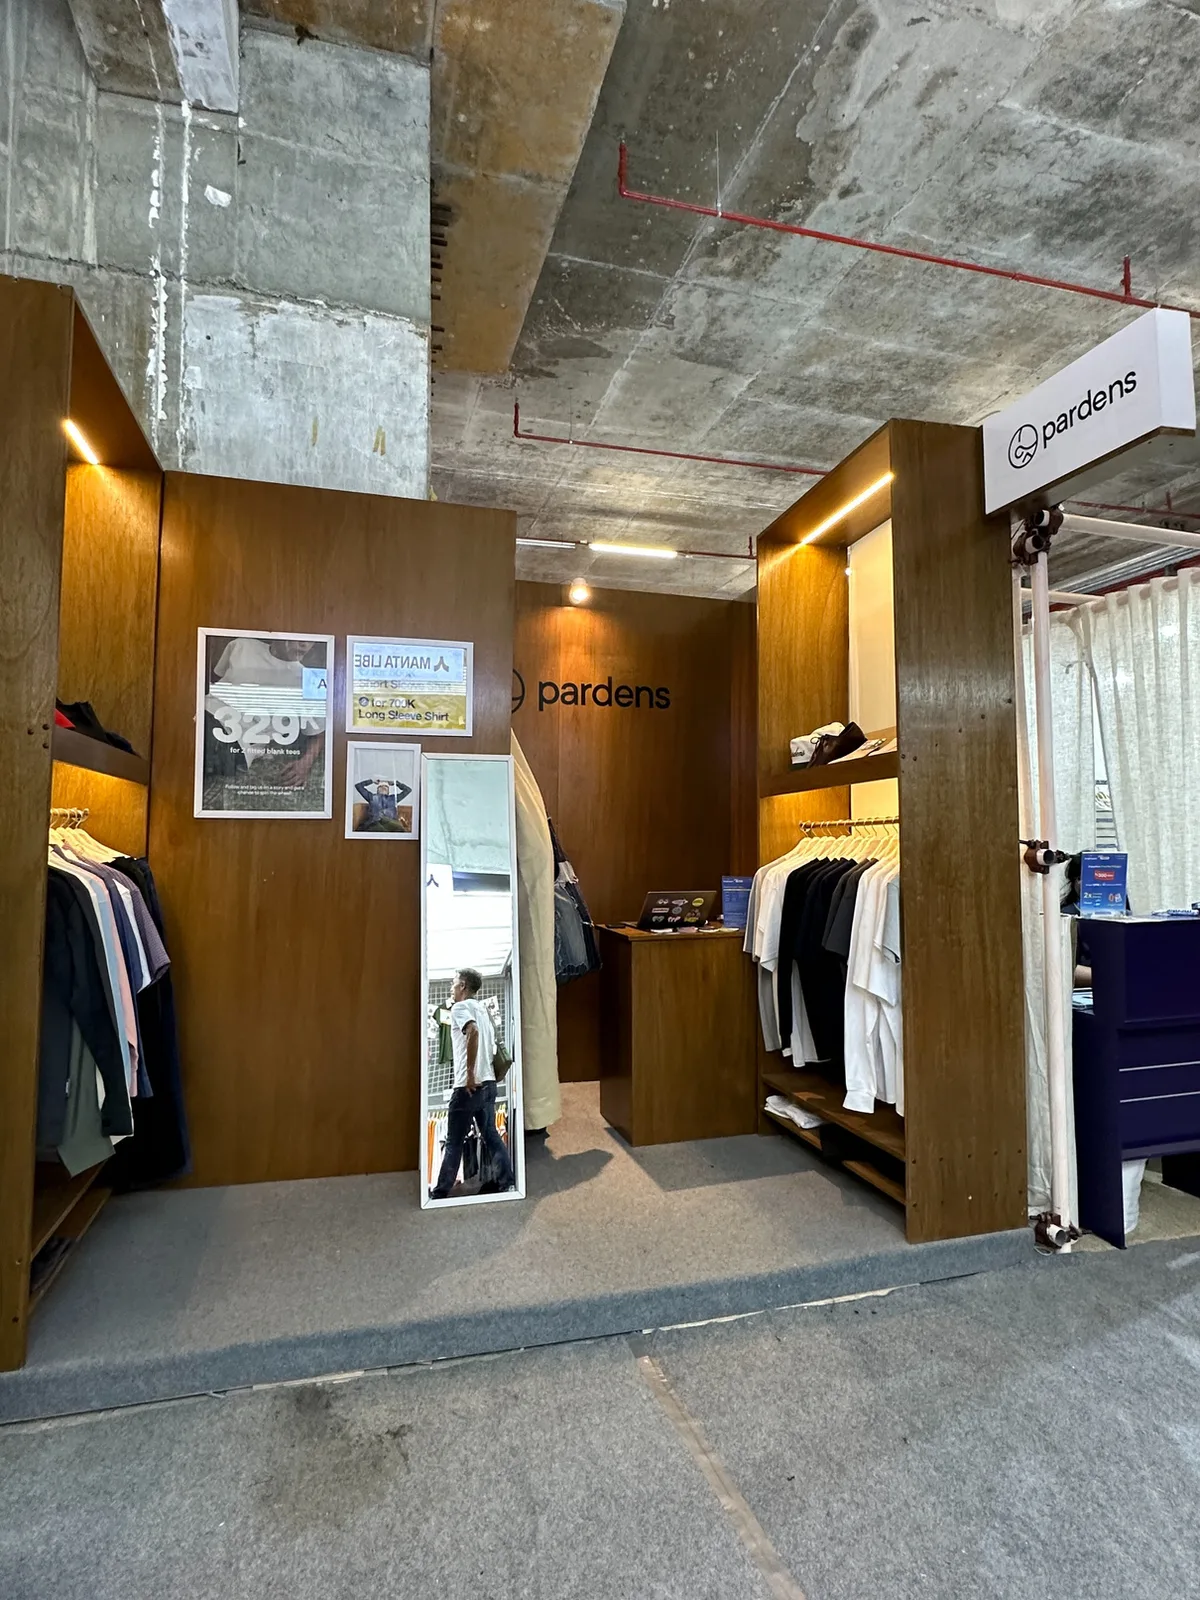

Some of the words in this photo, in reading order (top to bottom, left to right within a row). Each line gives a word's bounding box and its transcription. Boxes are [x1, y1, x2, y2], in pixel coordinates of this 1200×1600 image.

[1042, 371, 1136, 449] pardens
[538, 676, 671, 711] pardens
[371, 697, 387, 708] for
[358, 709, 386, 721] Long
[388, 710, 422, 721] Sleeve
[424, 711, 449, 722] Shirt
[246, 747, 266, 755] fitted
[266, 748, 285, 756] blank
